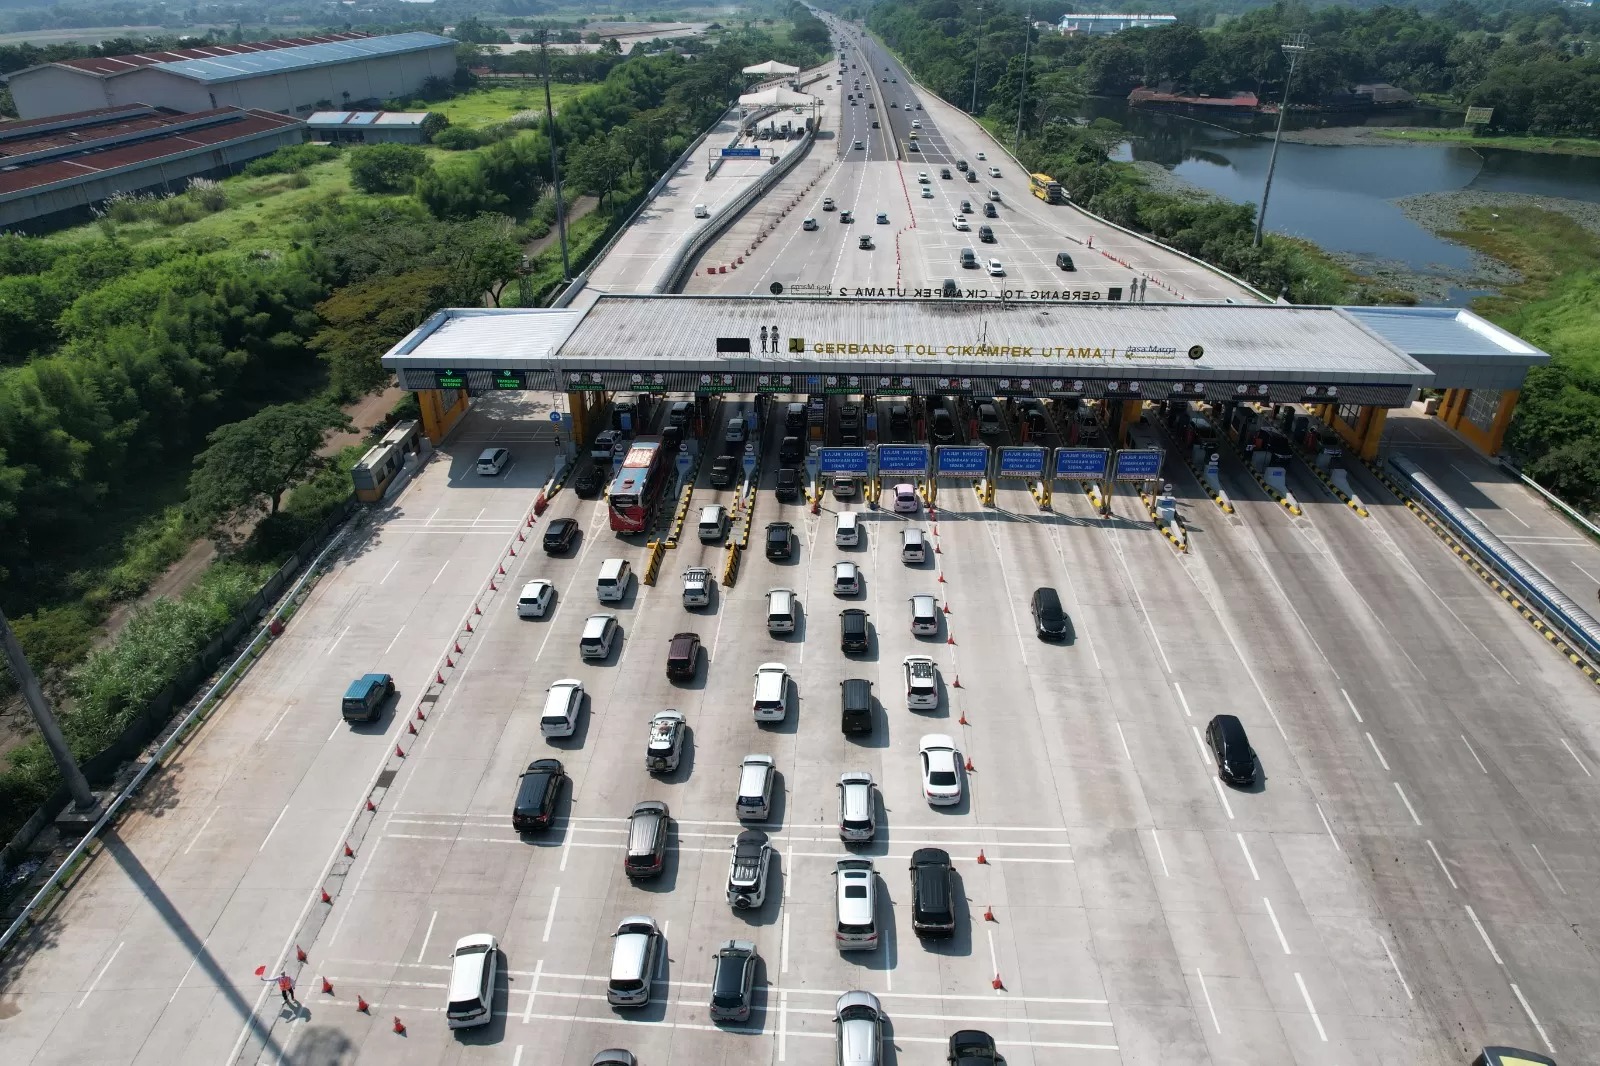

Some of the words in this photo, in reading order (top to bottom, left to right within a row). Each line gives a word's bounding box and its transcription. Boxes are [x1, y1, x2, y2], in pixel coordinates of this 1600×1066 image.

[813, 343, 895, 355] GERBANG
[904, 345, 937, 356] TOL
[946, 345, 1033, 358] CIKAMPEK
[1042, 347, 1103, 359] UTAMA
[1126, 345, 1146, 353] Jasa
[1148, 345, 1177, 355] Marga
